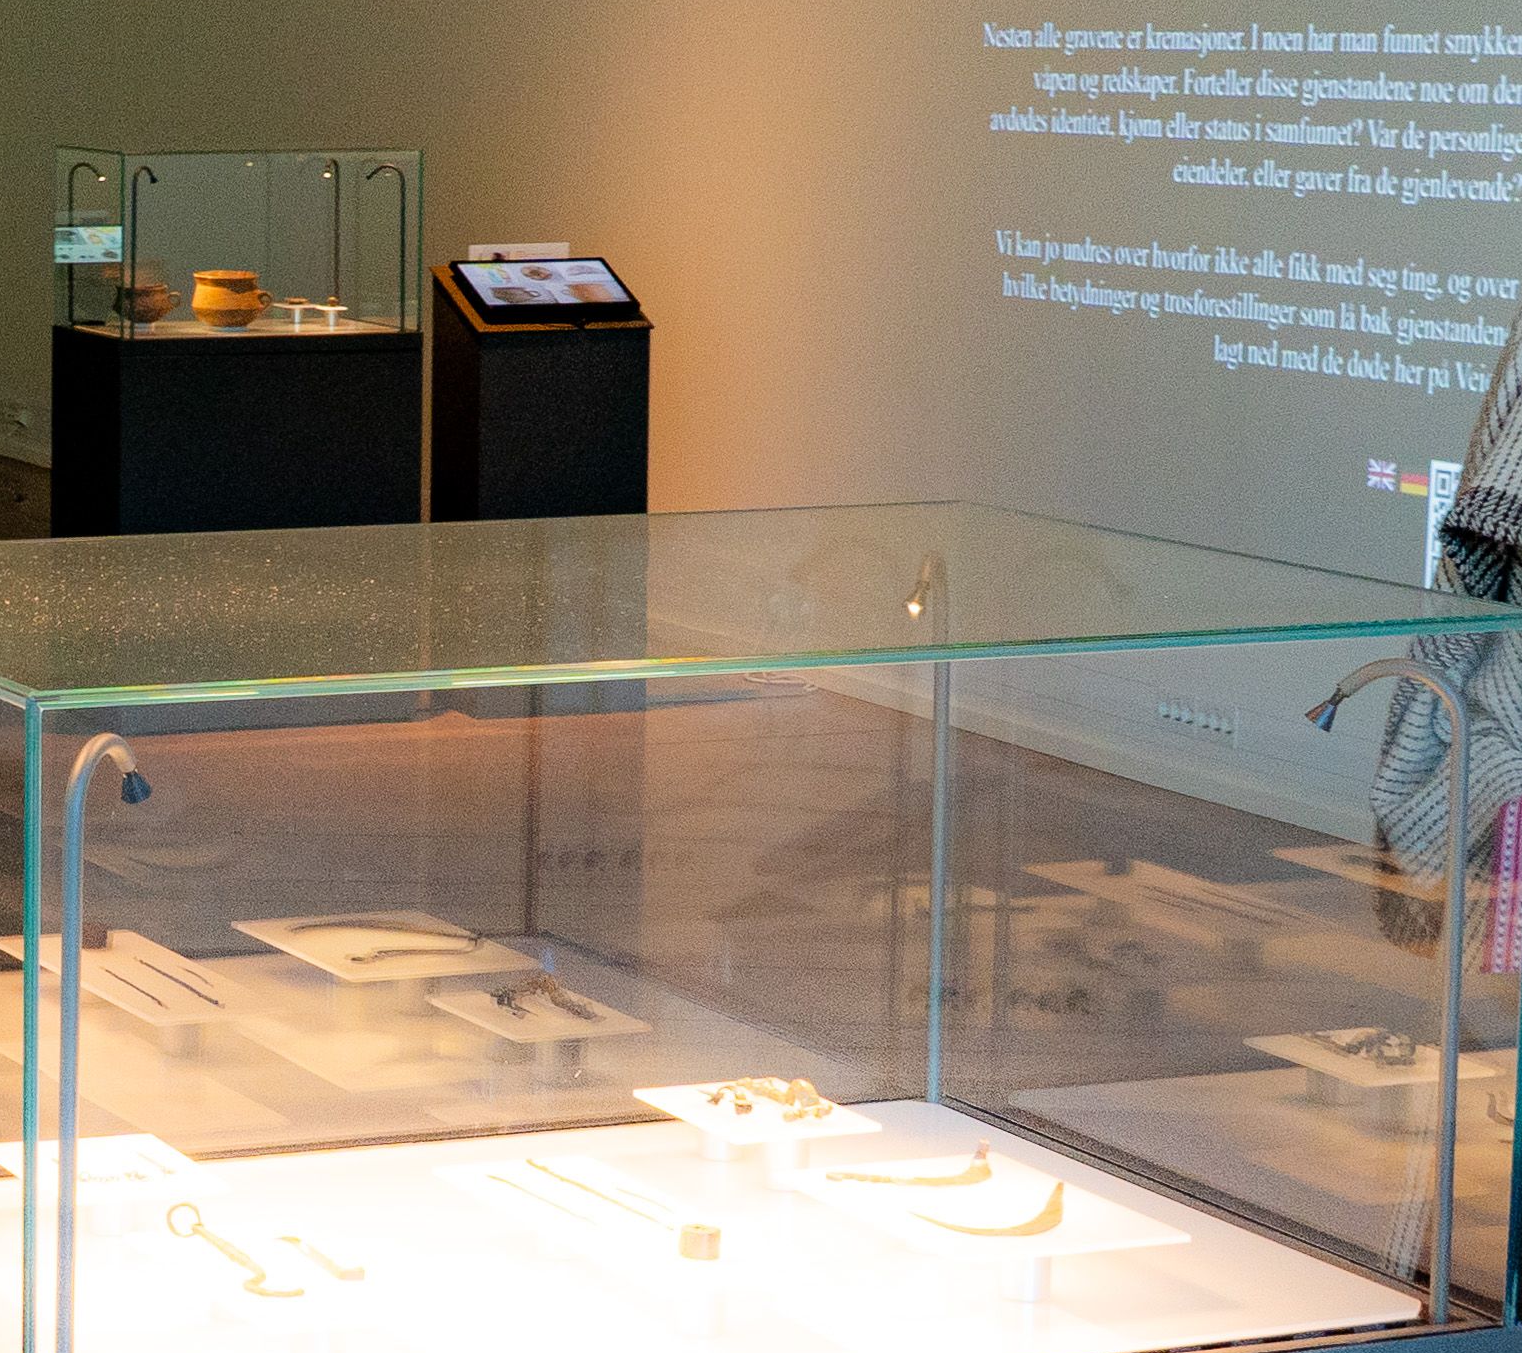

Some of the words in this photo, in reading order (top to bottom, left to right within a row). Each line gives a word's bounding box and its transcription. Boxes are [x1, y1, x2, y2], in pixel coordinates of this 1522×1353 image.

[983, 23, 1033, 48] Nesten
[1034, 22, 1063, 48] alle
[1064, 30, 1124, 56] gravene
[1125, 31, 1143, 50] er
[1261, 32, 1304, 52] noen
[1307, 24, 1336, 52] har
[1337, 32, 1378, 53] man
[1382, 24, 1440, 54] funnet
[1079, 74, 1100, 100] og
[1183, 68, 1253, 97] Forteller
[1255, 69, 1299, 98] disse
[1301, 71, 1416, 106] gjenstandene
[1419, 82, 1455, 104] noe
[1457, 83, 1489, 104] om
[1165, 112, 1202, 140] eller
[1203, 119, 1251, 141] status
[1264, 116, 1364, 146] samfunnet?
[1367, 119, 1399, 149] Var
[1401, 121, 1426, 150] de
[1253, 159, 1291, 189] eller
[1294, 170, 1344, 198] gaver
[1347, 165, 1372, 194] fra
[1374, 166, 1399, 196] de
[996, 230, 1013, 255] Vi
[1015, 231, 1042, 258] kan
[1043, 233, 1061, 265] jo
[1062, 236, 1112, 264] undres
[1113, 246, 1149, 267] over
[1151, 241, 1211, 273] hvorfor
[1214, 246, 1250, 275] ikke
[1252, 250, 1285, 278] alle
[1288, 252, 1322, 282] fikk
[1325, 258, 1364, 286] med
[1367, 268, 1398, 297] seg
[1447, 274, 1473, 303] og
[1475, 274, 1521, 301] over
[1003, 271, 1048, 300] hvilke
[1140, 292, 1161, 318] og
[1164, 288, 1297, 330] trosforestillinger
[1299, 308, 1336, 328] som
[1359, 304, 1393, 335] bak
[1396, 309, 1509, 347] gjenstanden
[1214, 335, 1244, 370] lagt
[1247, 340, 1278, 367] ned
[1281, 345, 1319, 372] med
[1321, 347, 1344, 376] de
[1394, 355, 1424, 386] her
[1427, 359, 1451, 395] på
[1454, 359, 1492, 393] Vei
